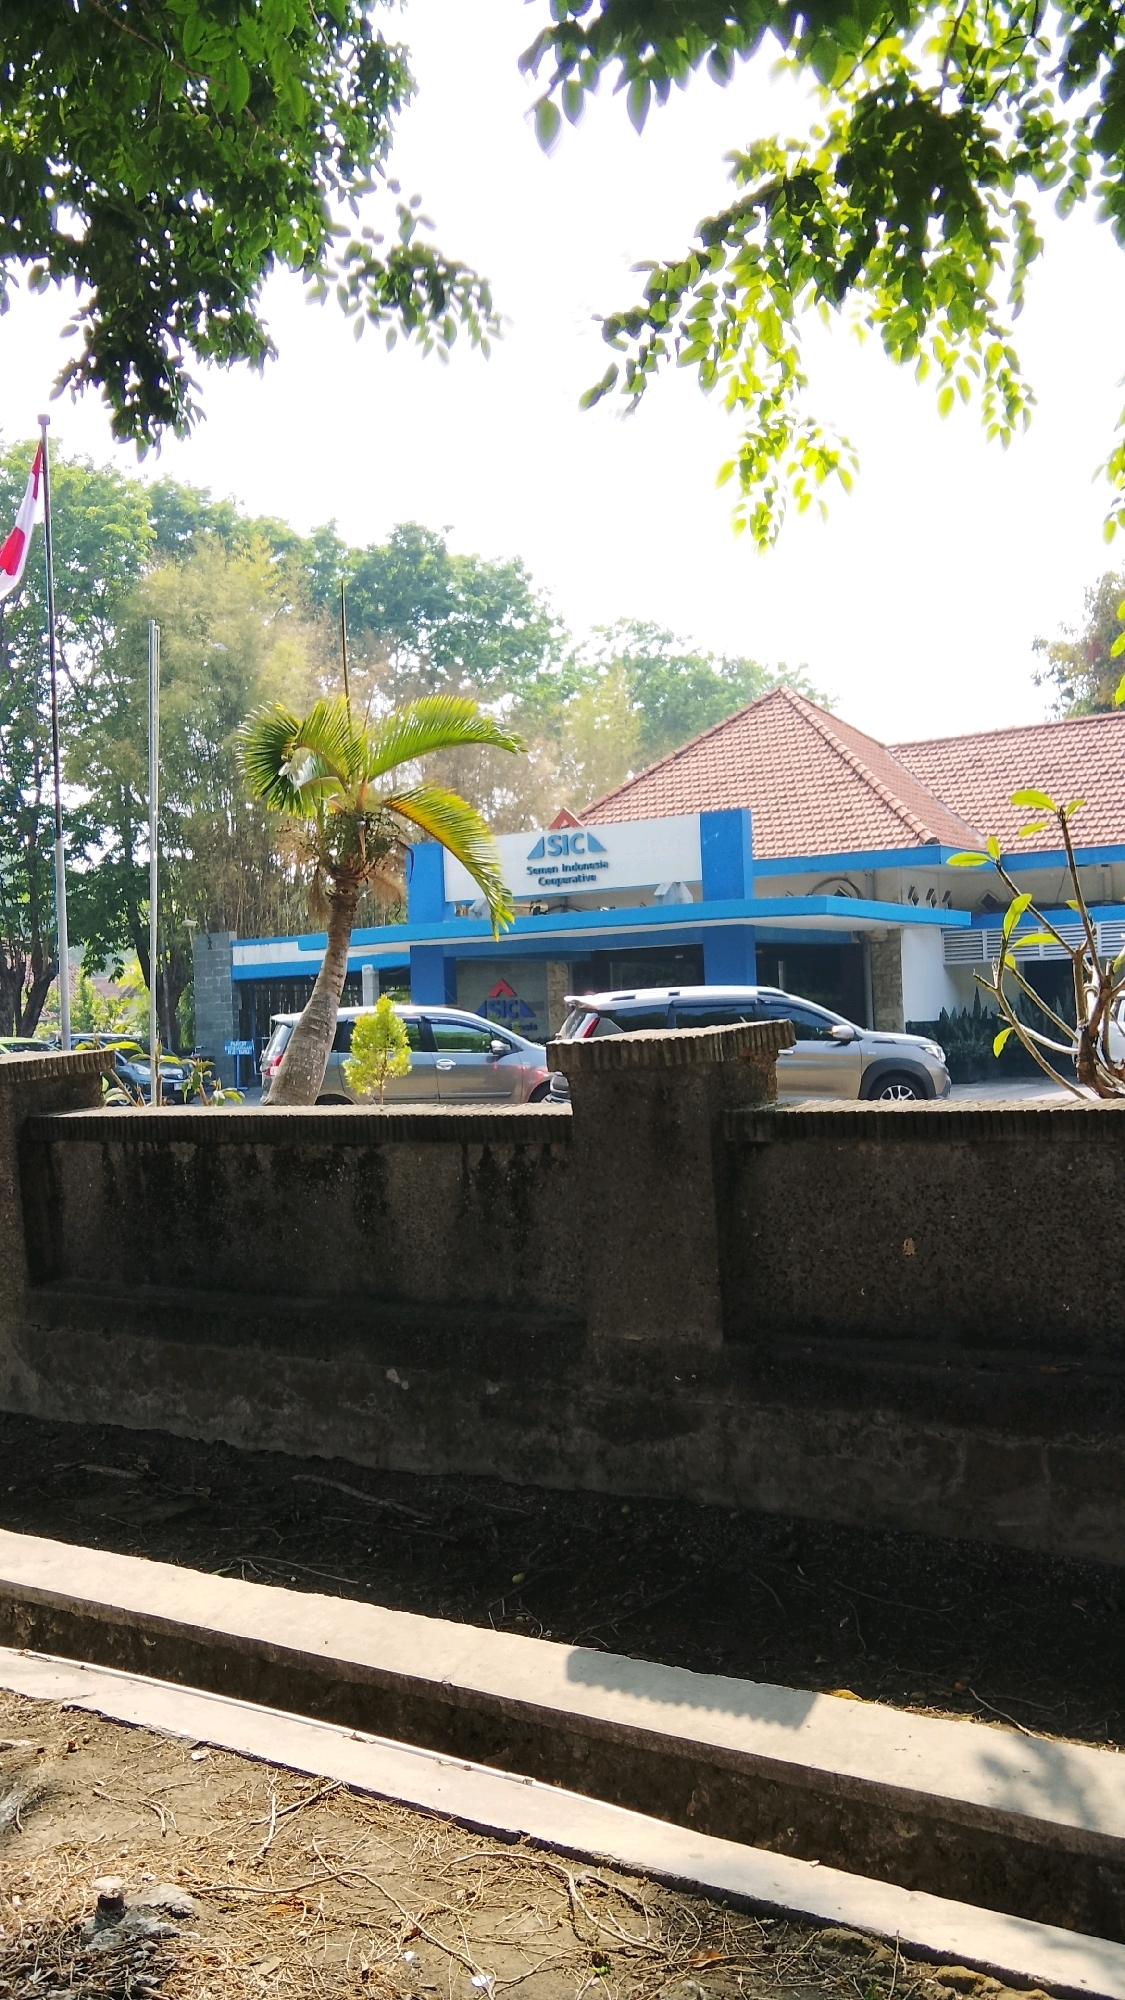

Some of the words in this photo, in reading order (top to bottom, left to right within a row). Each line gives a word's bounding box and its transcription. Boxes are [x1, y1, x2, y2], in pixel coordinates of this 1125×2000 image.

[547, 832, 585, 856] SIC
[526, 866, 559, 875] Semen
[562, 860, 609, 872] Indonesia
[538, 874, 597, 887] Cooperative
[487, 999, 519, 1019] SIC
